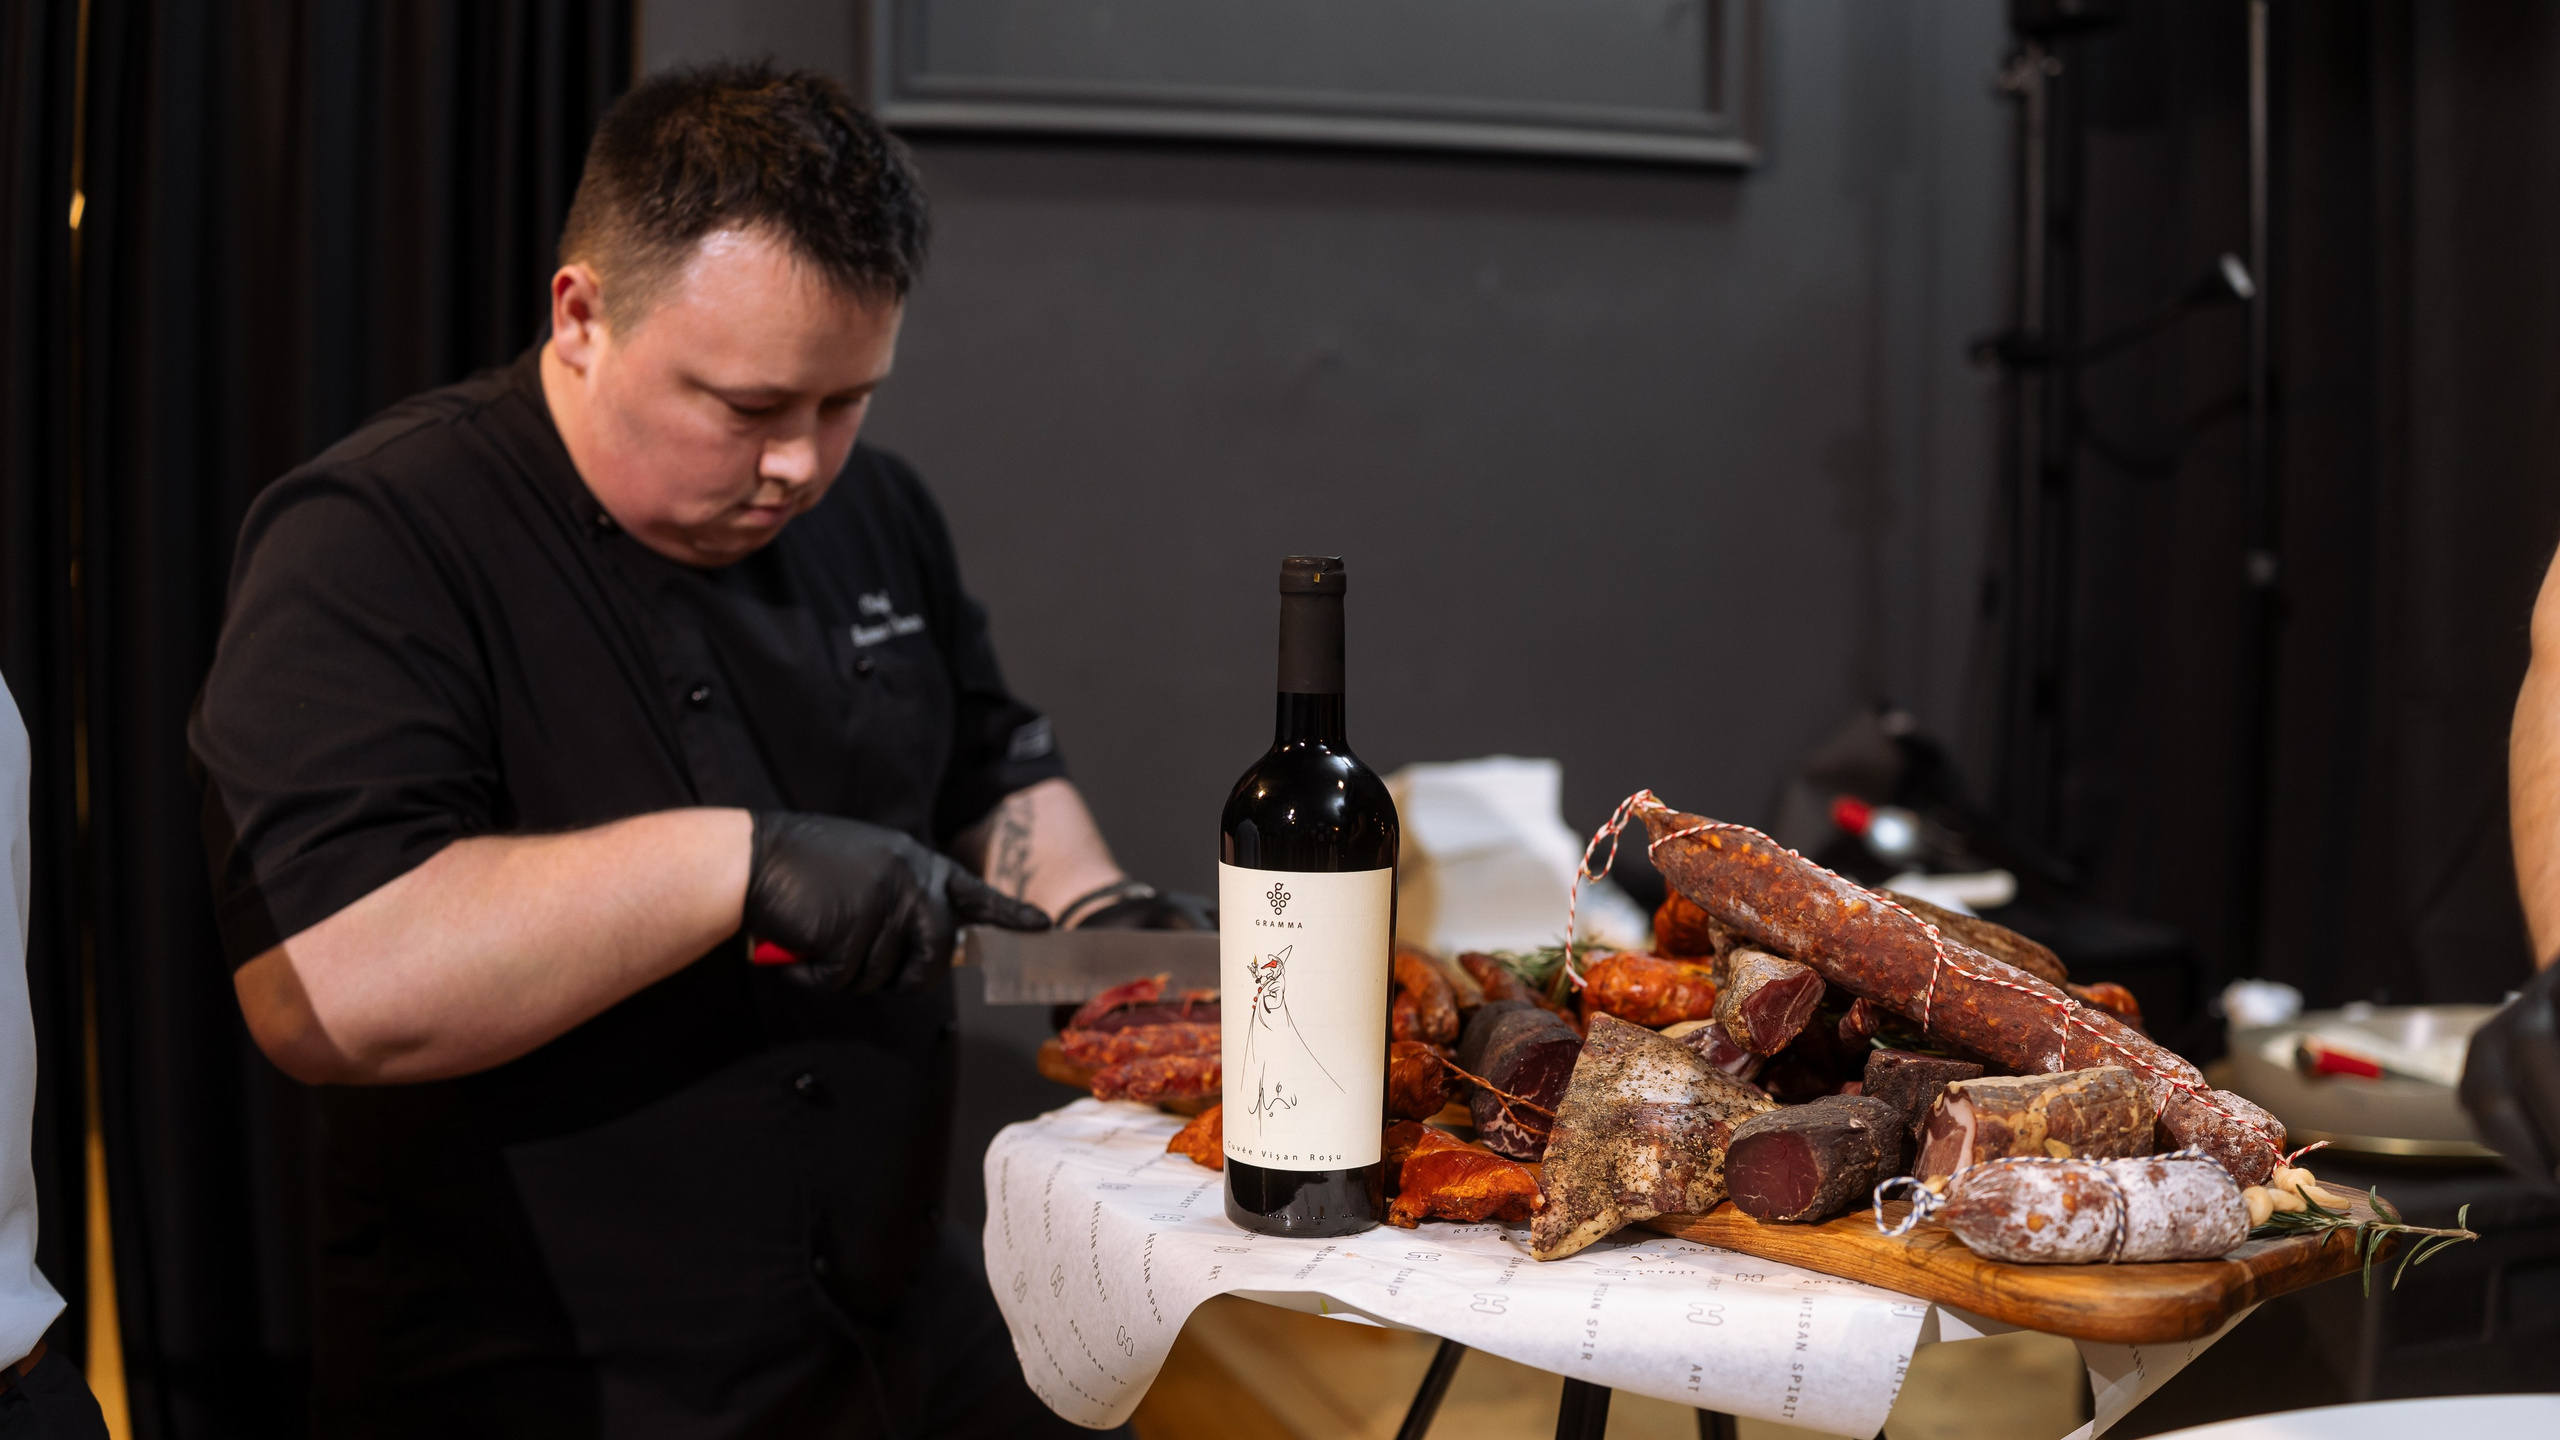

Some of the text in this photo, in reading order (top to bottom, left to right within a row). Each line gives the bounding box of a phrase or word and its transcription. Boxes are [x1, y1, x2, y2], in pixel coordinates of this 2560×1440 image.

[1255, 919, 1303, 929] GRAMMA
[1091, 1200, 1107, 1303] ARTISAN SPIRIT
[1143, 1232, 1157, 1284] ARTISAN
[1208, 1265, 1222, 1281] ART
[1070, 1319, 1104, 1372] ARTISAN
[1688, 1364, 1703, 1392] ART
[1782, 1362, 1804, 1419] SPIRIT
